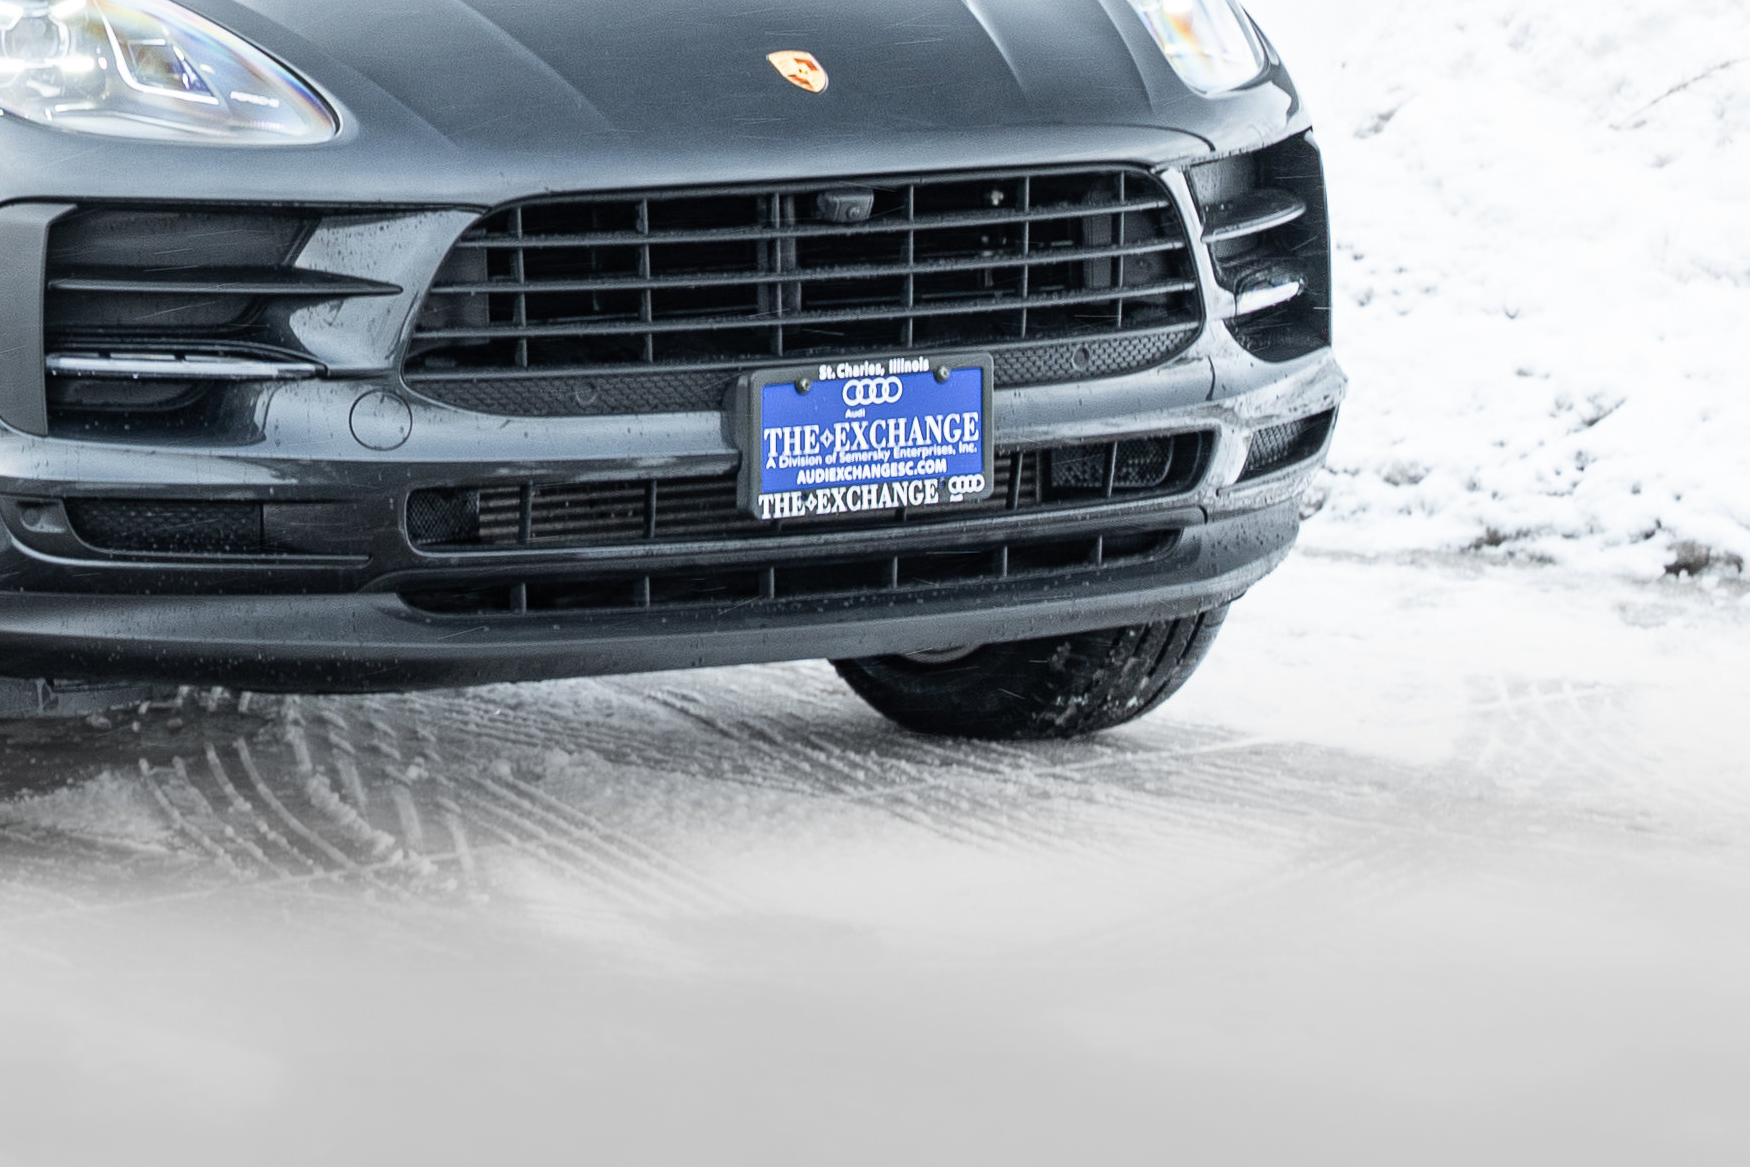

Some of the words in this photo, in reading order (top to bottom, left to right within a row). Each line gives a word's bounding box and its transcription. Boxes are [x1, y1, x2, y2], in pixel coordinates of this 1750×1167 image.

[819, 364, 836, 380] St.
[836, 360, 886, 379] Charles,
[888, 355, 930, 375] Illinois
[844, 407, 866, 419] Audi
[763, 424, 820, 458] THE
[833, 411, 980, 453] EXCHANGE
[766, 456, 777, 470] A
[778, 454, 823, 469] Division
[824, 449, 838, 465] of
[838, 445, 891, 464] Semersky
[893, 443, 957, 460] Enterprises,
[958, 440, 978, 454] Inc.
[796, 457, 948, 486] AUDIEXCHANGESC.COM
[757, 490, 806, 520] THE
[815, 478, 939, 515] EXCHANGE
